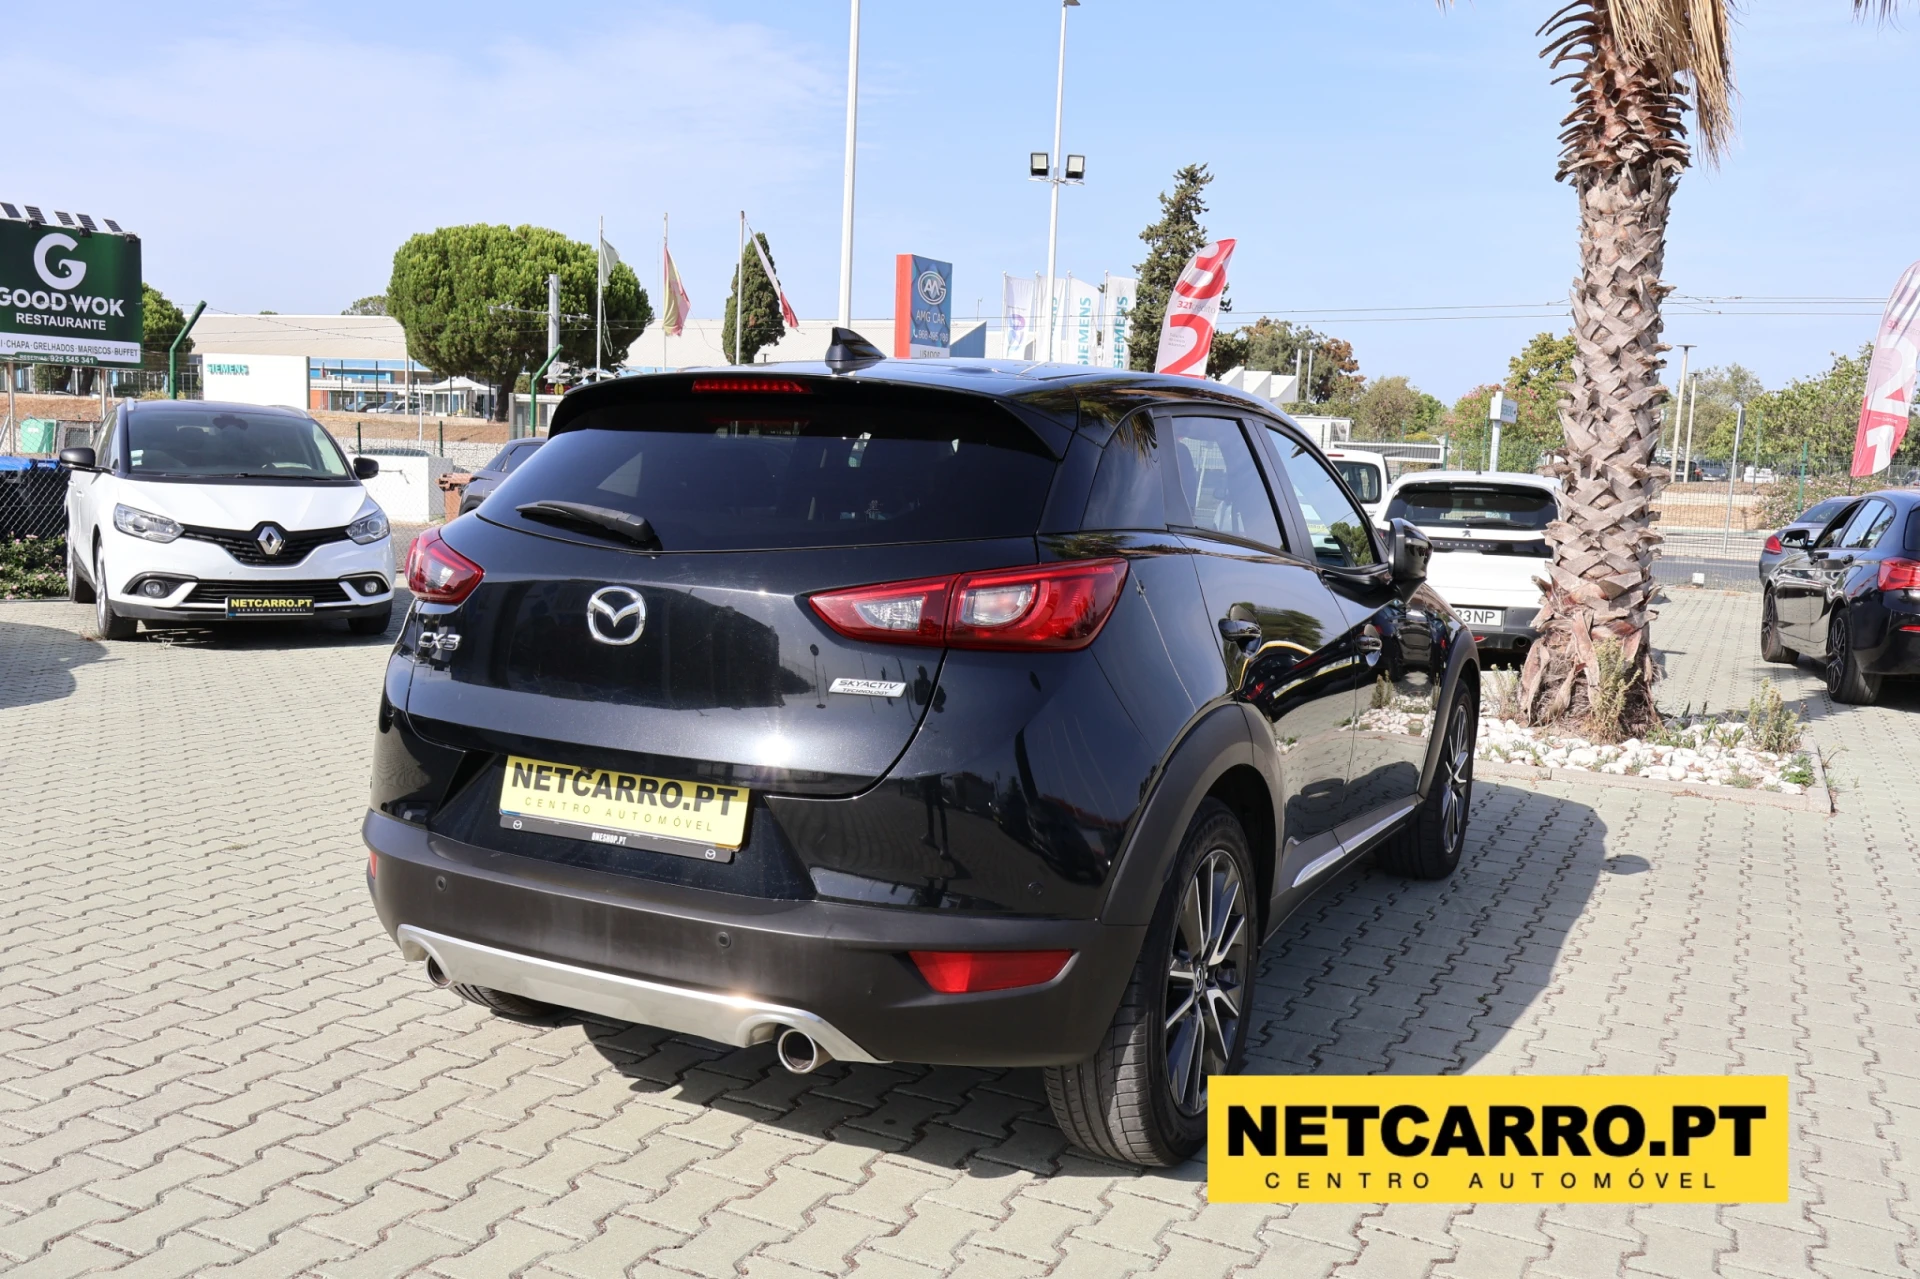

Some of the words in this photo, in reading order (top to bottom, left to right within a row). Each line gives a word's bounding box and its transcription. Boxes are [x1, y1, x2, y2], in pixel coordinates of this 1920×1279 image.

[0, 286, 67, 311] GOOD
[70, 294, 125, 317] WOK
[16, 312, 106, 331] RESTAURANTE
[915, 309, 931, 323] AMG
[932, 312, 946, 325] CAR
[1113, 296, 1128, 369] SIEMENS
[5, 340, 30, 349] CHAPA
[33, 342, 75, 353] GRELHADOS
[78, 345, 111, 355] MARISCOS
[114, 348, 138, 357] BUFFET
[207, 364, 249, 374] SIEMENS
[231, 599, 312, 607] NETCARRO.PT
[1473, 610, 1495, 624] NP
[418, 631, 462, 651] CX-3
[838, 680, 899, 689] SKYACTIV
[842, 687, 889, 696] TECHNOLOGY
[511, 761, 739, 816] NETCARRO.PT
[524, 796, 591, 815] CENTRO
[605, 807, 713, 832] AUTOMÓVEL
[591, 831, 627, 846] ONESHOP.PT
